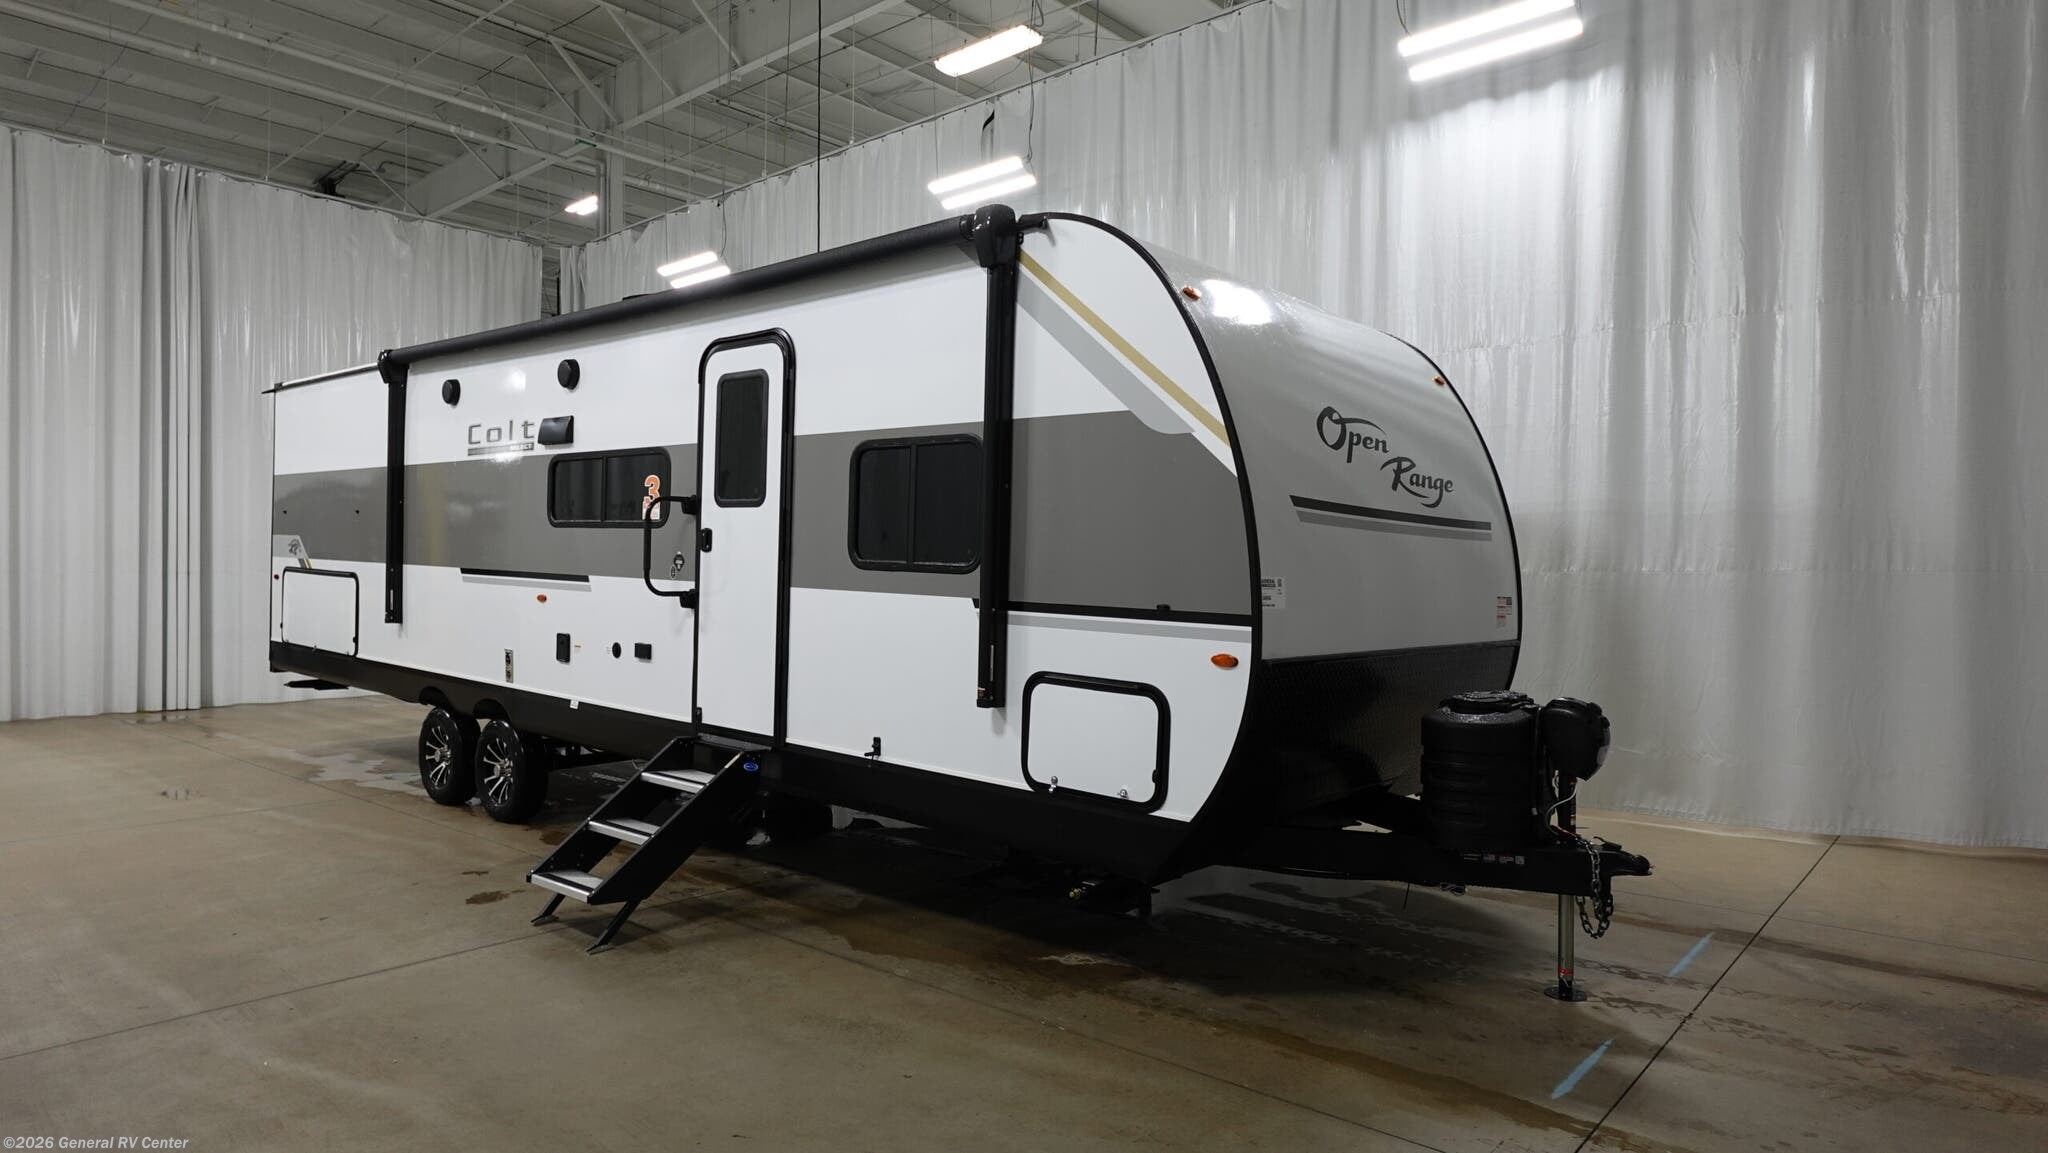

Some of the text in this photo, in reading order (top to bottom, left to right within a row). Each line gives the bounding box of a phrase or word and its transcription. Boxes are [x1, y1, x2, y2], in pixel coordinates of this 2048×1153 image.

[467, 419, 535, 445] Colt
[1316, 406, 1389, 464] Open
[1380, 456, 1454, 509] Range
